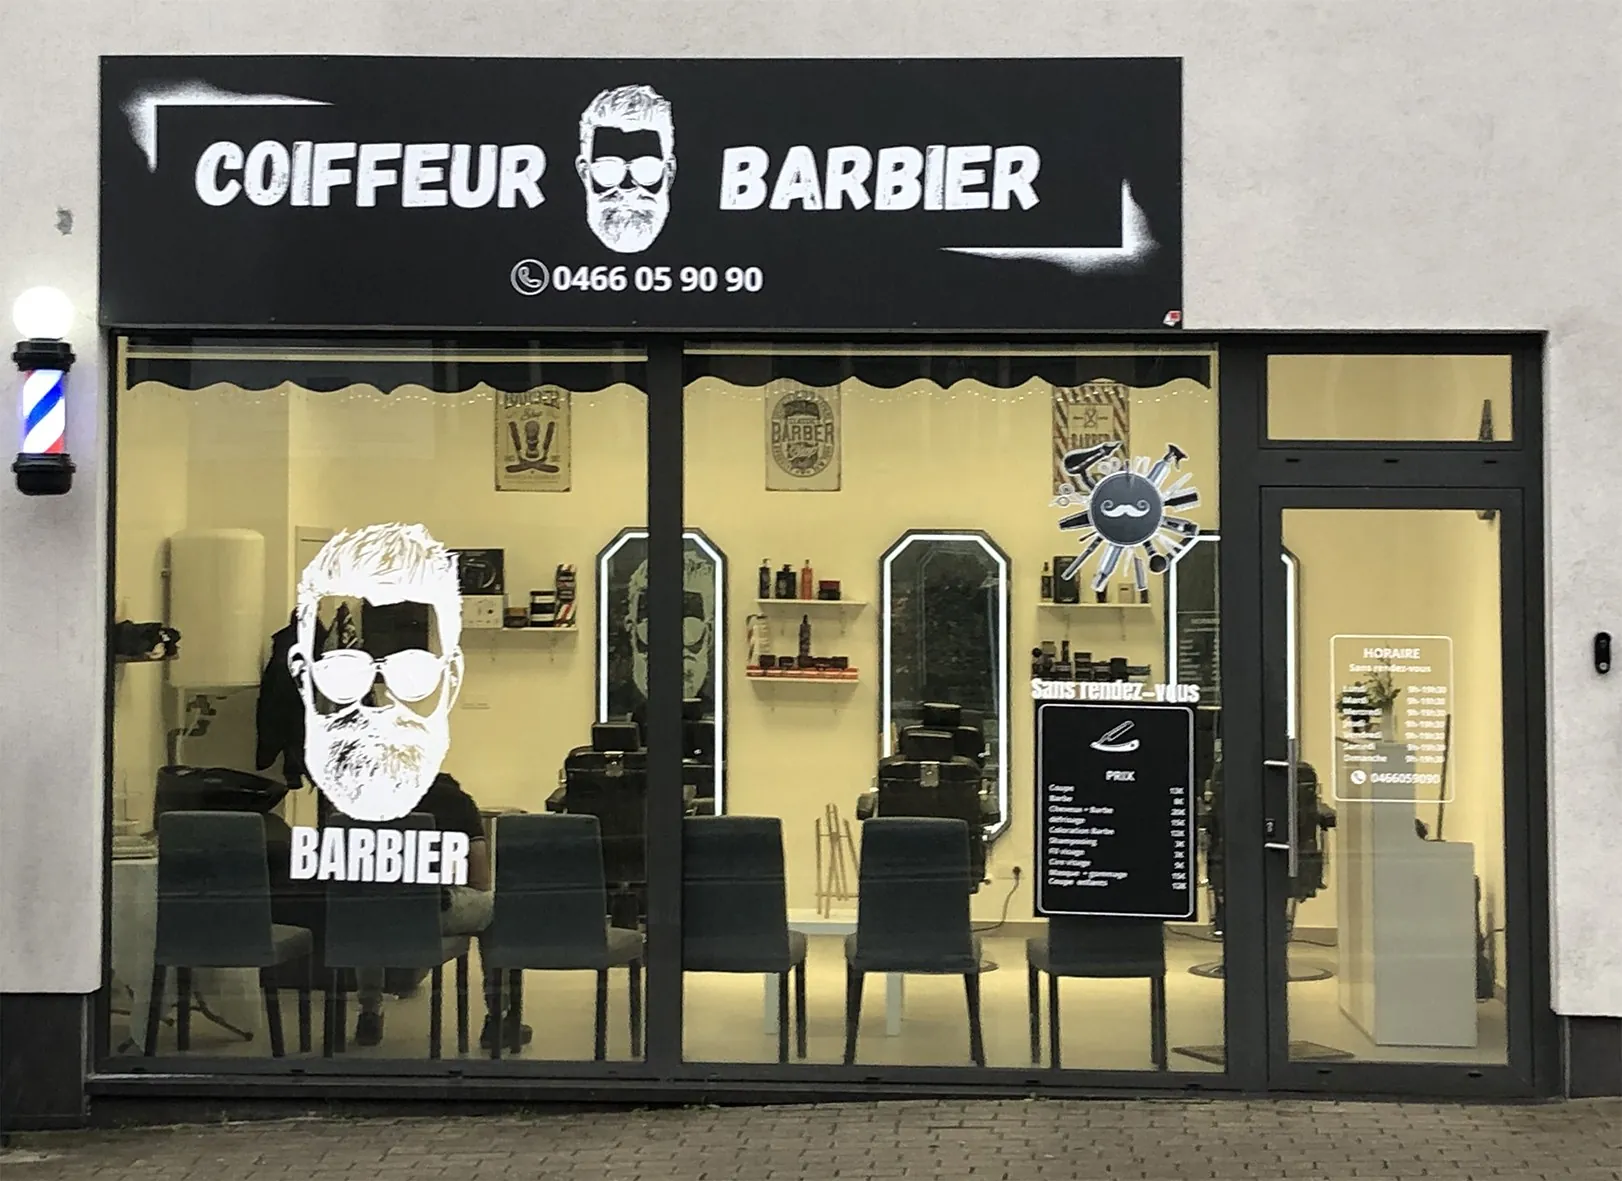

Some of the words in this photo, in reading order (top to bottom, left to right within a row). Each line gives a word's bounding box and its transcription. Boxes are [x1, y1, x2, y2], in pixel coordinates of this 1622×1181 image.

[194, 140, 547, 208] COIFFEUR
[718, 144, 1041, 211] BARBIER
[552, 265, 628, 291] 0466
[634, 266, 673, 292] 05
[679, 266, 718, 292] 90
[724, 266, 764, 292] 90
[1363, 648, 1421, 659] HORAIRE
[1349, 663, 1372, 672] Sans
[1031, 678, 1076, 700] Sans
[1079, 680, 1200, 703] rendez-vous
[1105, 771, 1136, 781] PRIX
[289, 826, 471, 886] BARBIER
